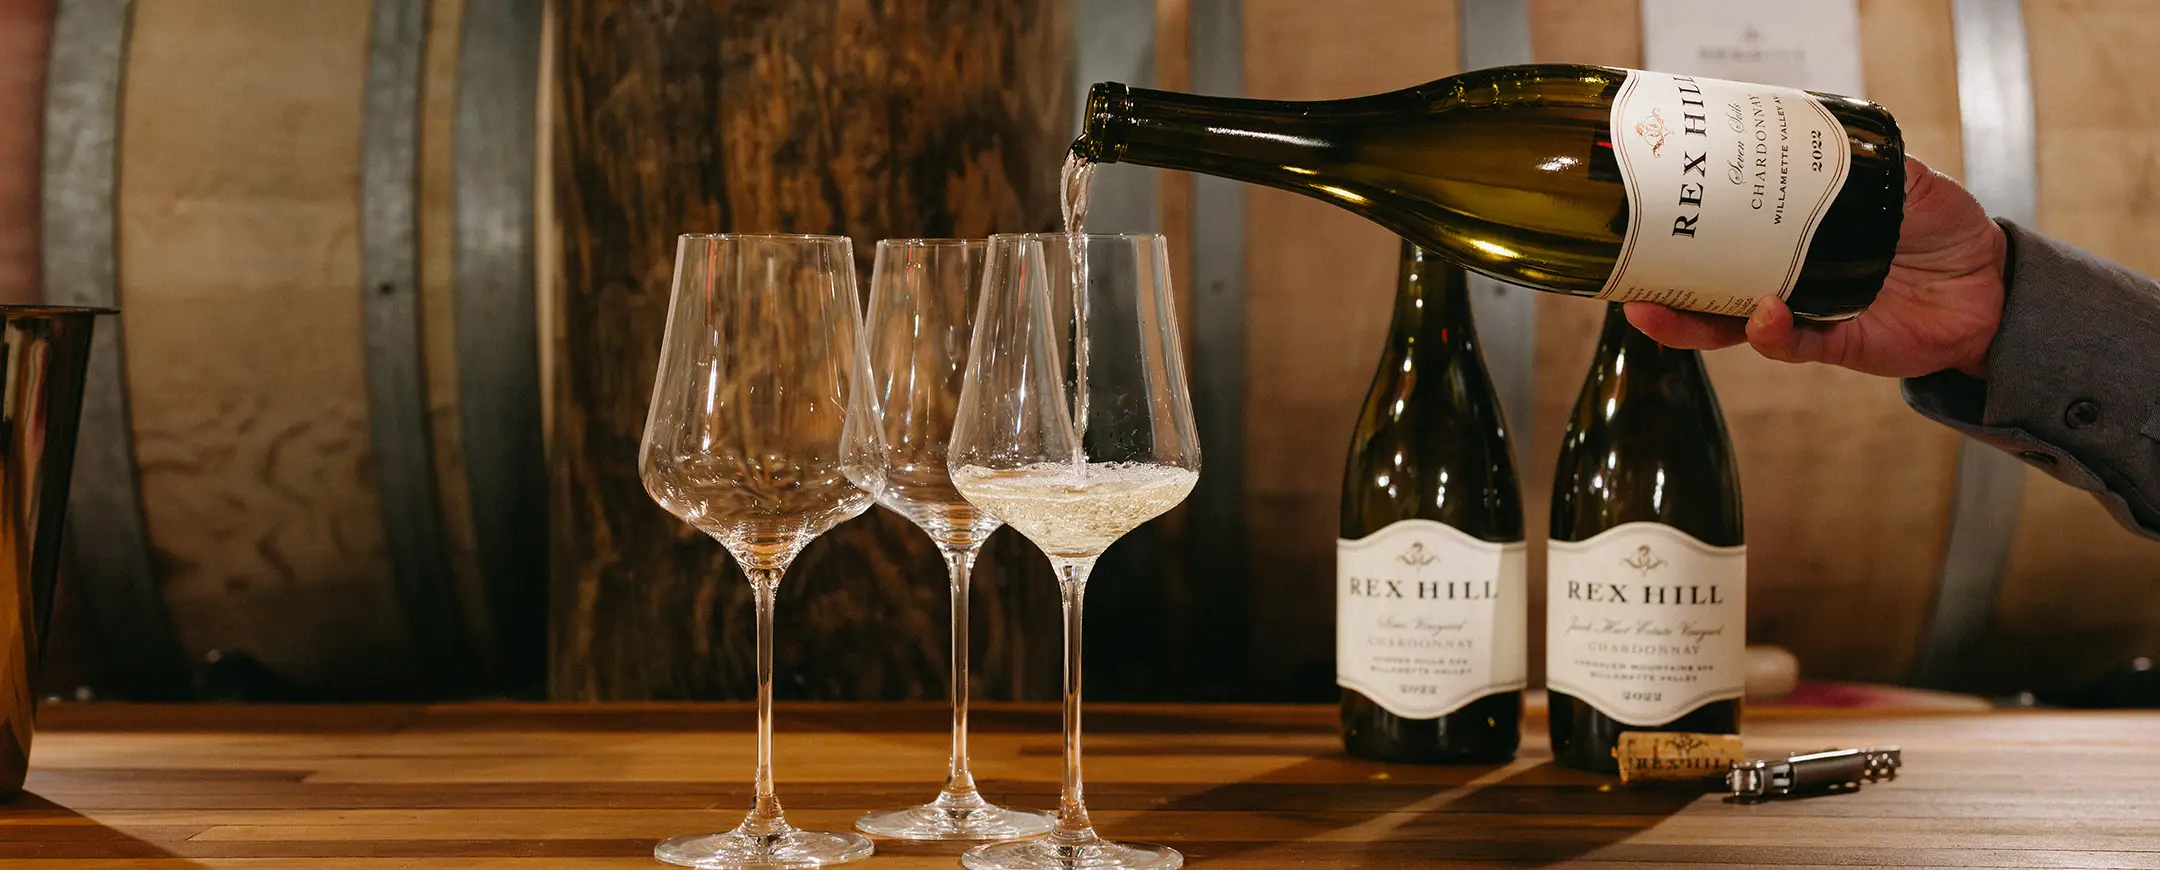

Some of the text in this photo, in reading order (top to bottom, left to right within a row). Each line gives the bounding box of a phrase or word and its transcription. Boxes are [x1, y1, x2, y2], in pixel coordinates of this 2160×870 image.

[1776, 107, 1788, 141] VALLEY
[1672, 76, 1707, 239] REX HILL
[1726, 102, 1747, 186] Seven Soils
[1748, 94, 1767, 210] CHARDONNAY
[1811, 130, 1823, 172] 2022
[1773, 145, 1789, 225] WILLAMETTE
[1350, 576, 1499, 600] REX HILL
[1568, 581, 1724, 605] REX HILL
[1368, 637, 1473, 649] CHARDONNAY
[1588, 643, 1700, 655] CHARDONNAY
[1622, 691, 1662, 702] 2022
